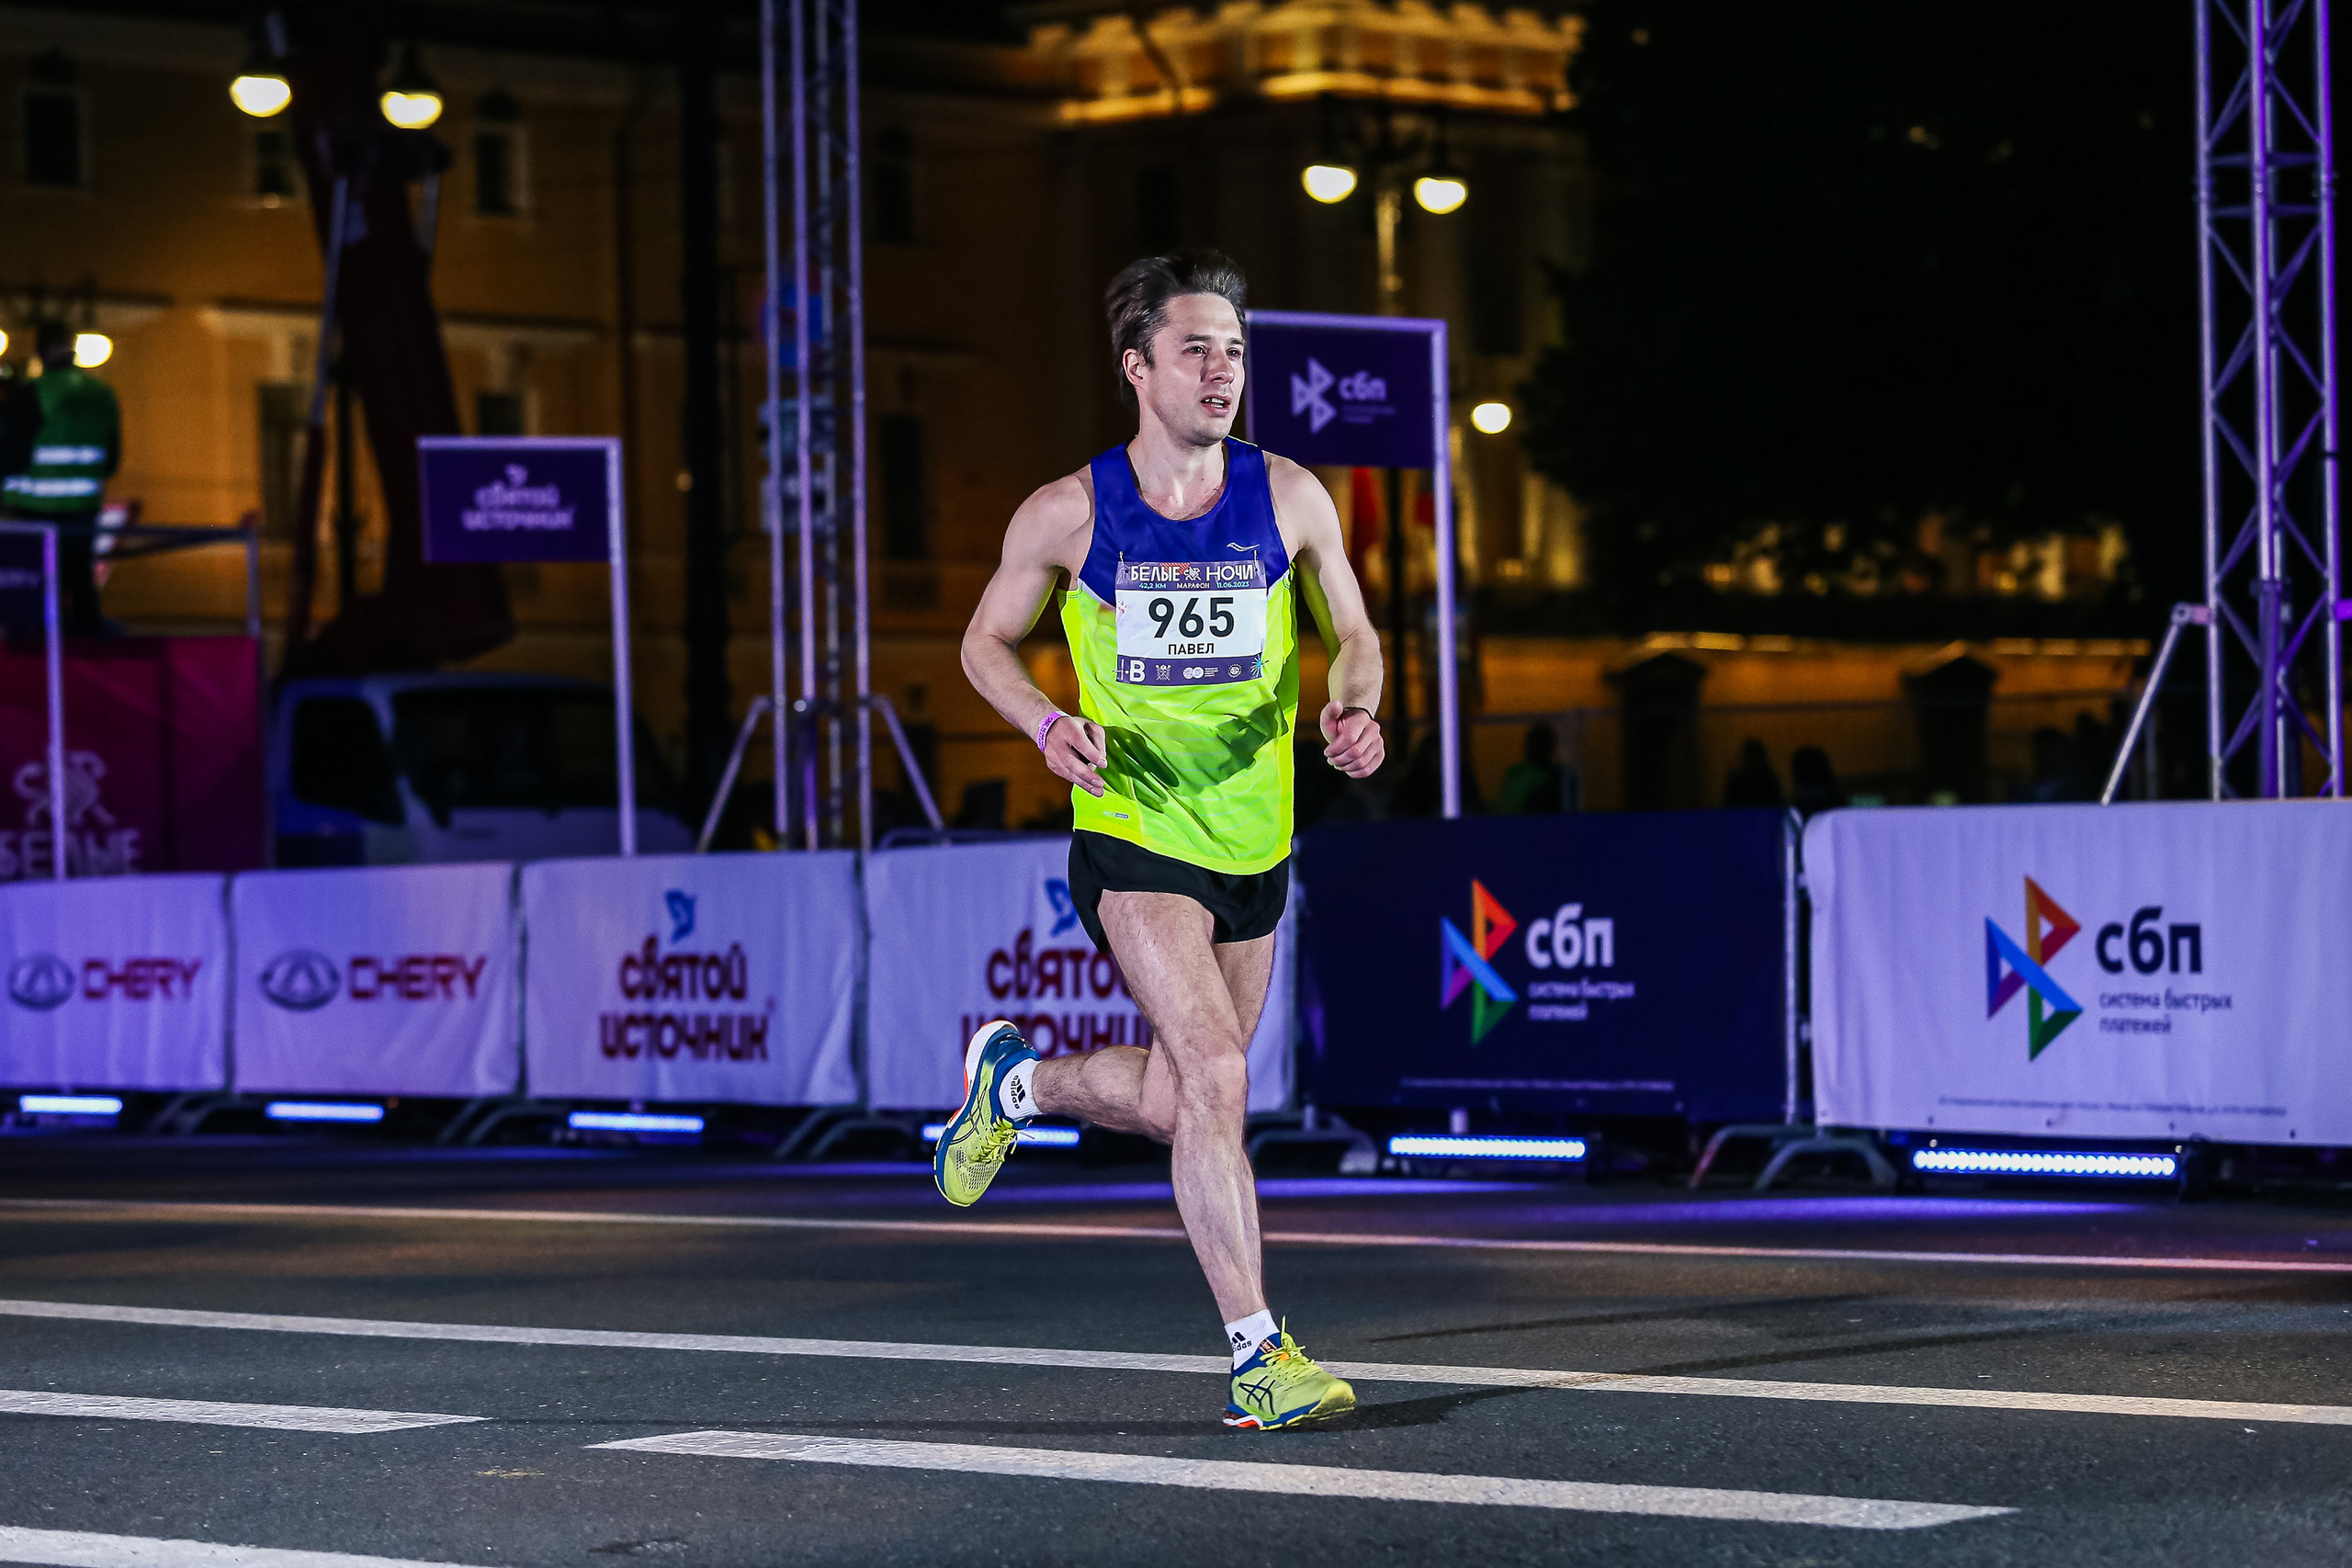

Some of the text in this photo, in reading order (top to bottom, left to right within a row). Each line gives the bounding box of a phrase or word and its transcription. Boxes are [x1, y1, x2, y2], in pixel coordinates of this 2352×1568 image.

[1131, 565, 1253, 581] БЕЛЫЕ НОЧИ
[1148, 597, 1234, 638] 965
[1168, 643, 1215, 655] ПАВЕЛ
[1525, 902, 1614, 969] сбп
[2096, 907, 2203, 975] сбп
[84, 957, 202, 1001] CHERY
[349, 955, 487, 1002] CHERY
[987, 927, 1133, 999] свято
[1010, 1075, 1021, 1110] adidas
[1232, 1340, 1252, 1353] idas
